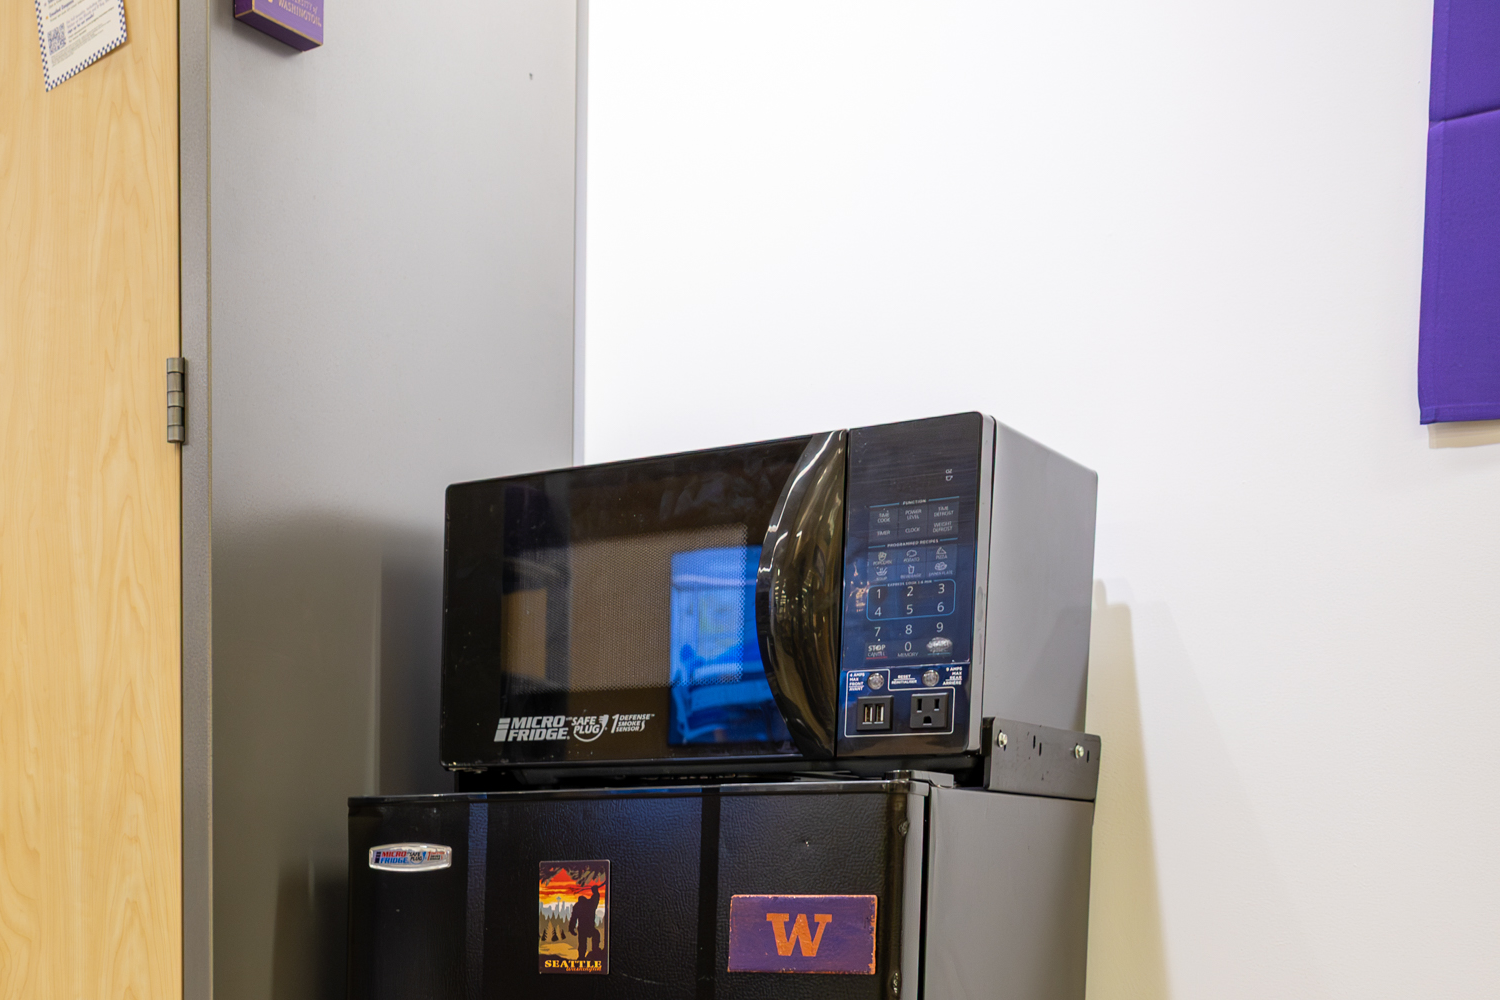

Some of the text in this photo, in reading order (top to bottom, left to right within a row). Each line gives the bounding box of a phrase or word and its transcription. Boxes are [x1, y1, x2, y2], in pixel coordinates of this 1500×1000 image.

[886, 540, 920, 548] PROGRAMMED
[876, 583, 945, 599] 1 2 3
[874, 601, 945, 617] 4 5 6
[874, 621, 944, 637] 7 8 9
[867, 644, 886, 652] STOP
[904, 641, 912, 652] 0
[510, 715, 566, 730] MICRO
[570, 715, 597, 727] SAFE
[507, 727, 569, 742] FRIDGE
[573, 724, 601, 735] PLUG
[765, 912, 833, 958] W
[544, 959, 602, 969] SEATTLE
